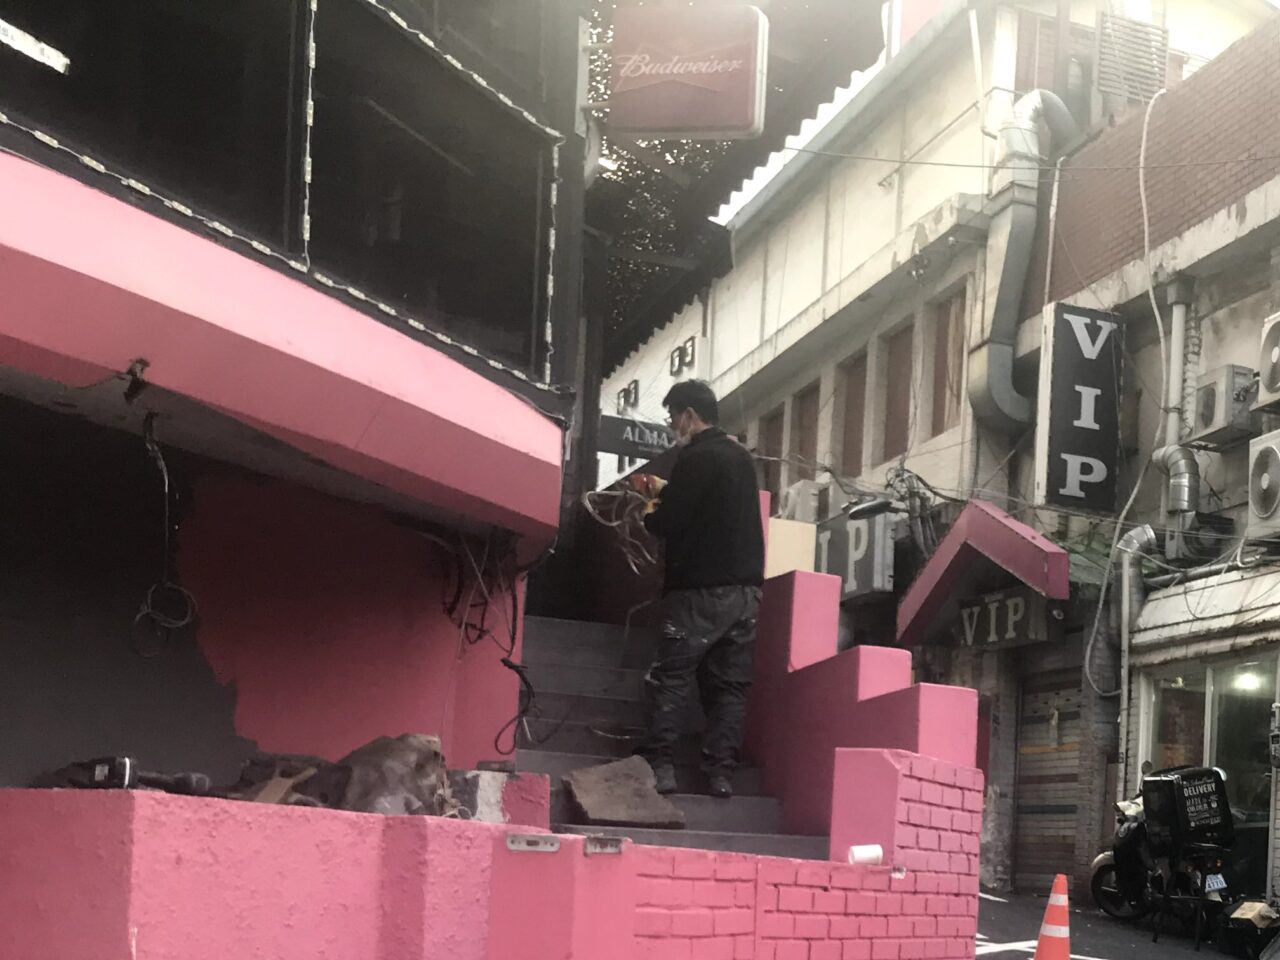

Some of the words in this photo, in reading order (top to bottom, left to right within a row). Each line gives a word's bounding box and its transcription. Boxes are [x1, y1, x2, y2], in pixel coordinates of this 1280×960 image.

[616, 54, 743, 77] Budweiser
[1059, 313, 1118, 498] VIP
[961, 597, 1025, 645] VIP
[1183, 782, 1216, 797] DELIVERY
